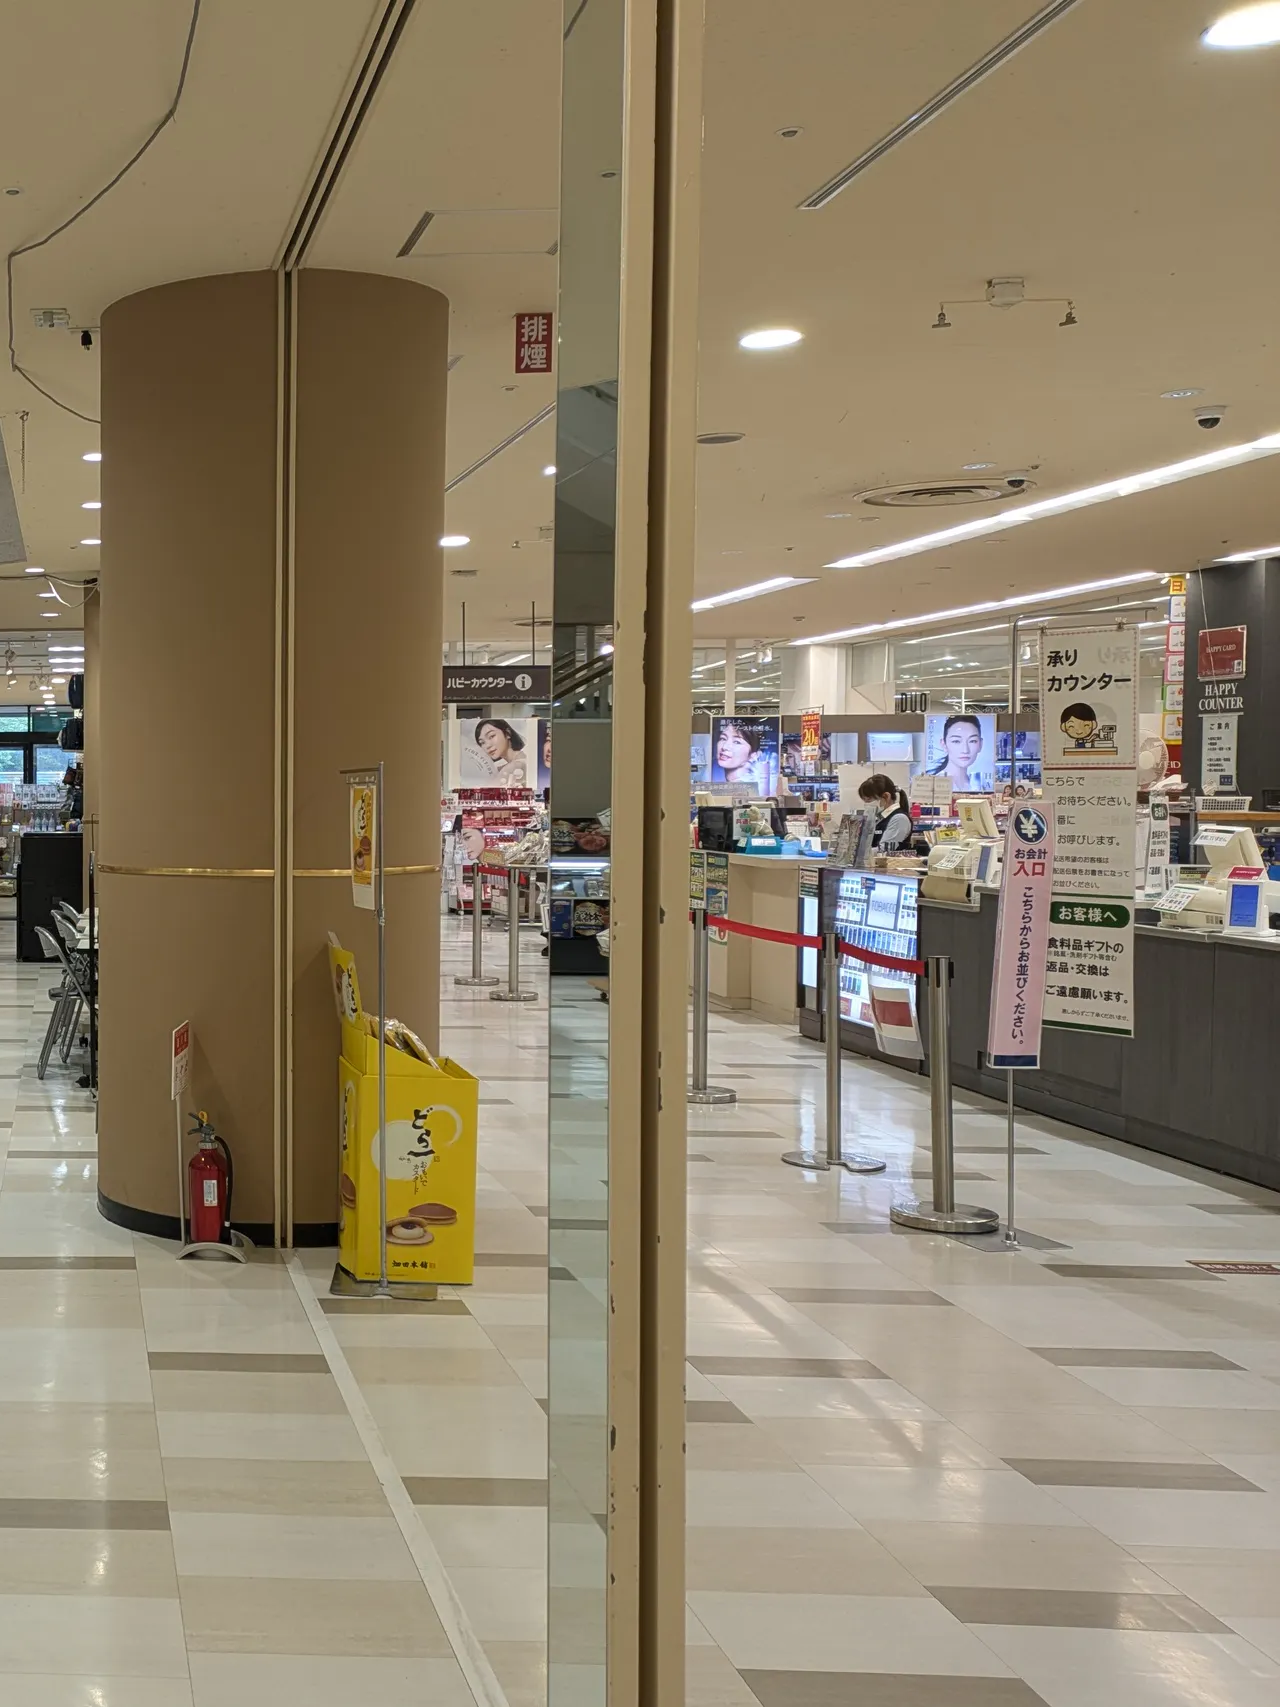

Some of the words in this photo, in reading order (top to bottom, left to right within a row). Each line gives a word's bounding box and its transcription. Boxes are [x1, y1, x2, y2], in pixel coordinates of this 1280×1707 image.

[520, 316, 548, 369] 排煙
[1046, 649, 1078, 668] 承り
[1047, 672, 1132, 692] カウンター
[1204, 683, 1238, 696] HAPPY
[1198, 697, 1244, 711] COUNTER
[1045, 776, 1085, 787] こちらで
[1057, 796, 1131, 807] お待ちください。
[1057, 815, 1076, 825] 番に
[1057, 835, 1120, 847] お呼びします。
[1014, 849, 1048, 859] お会計
[1013, 861, 1045, 877] 入口
[1058, 906, 1118, 922] お客様へ
[1047, 937, 1124, 953] 食料品ギフトの
[1011, 887, 1034, 1045] こちらからお並びください。
[1046, 961, 1110, 977] 返品・交換は
[1045, 985, 1128, 1004] ご遠慮願います。
